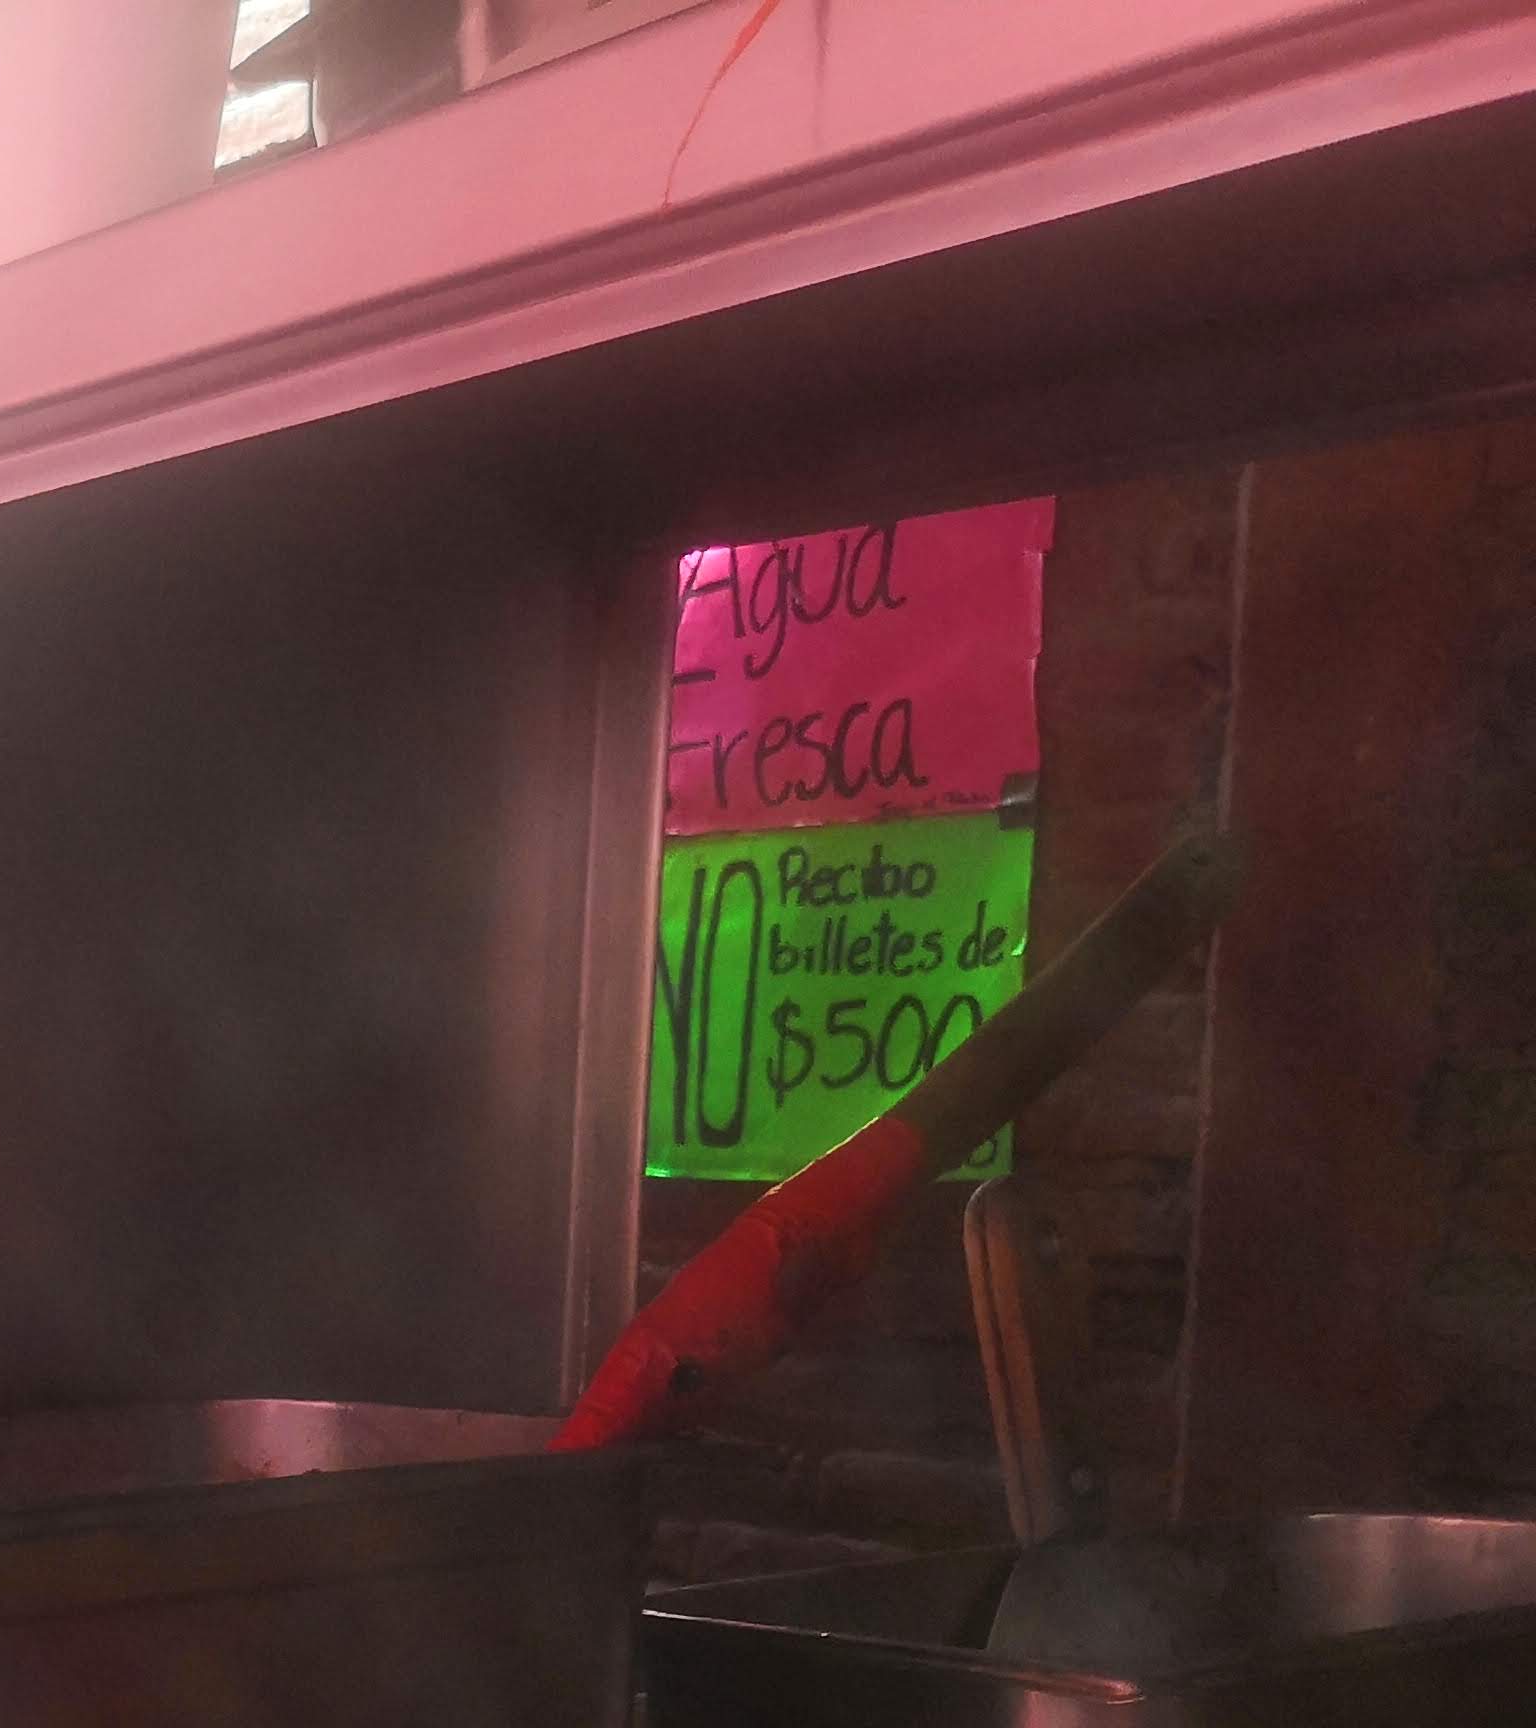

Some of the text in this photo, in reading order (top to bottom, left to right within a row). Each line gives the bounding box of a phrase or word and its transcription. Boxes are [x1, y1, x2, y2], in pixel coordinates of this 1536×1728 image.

[681, 526, 907, 680] Agua
[768, 900, 1009, 978] billetes de
